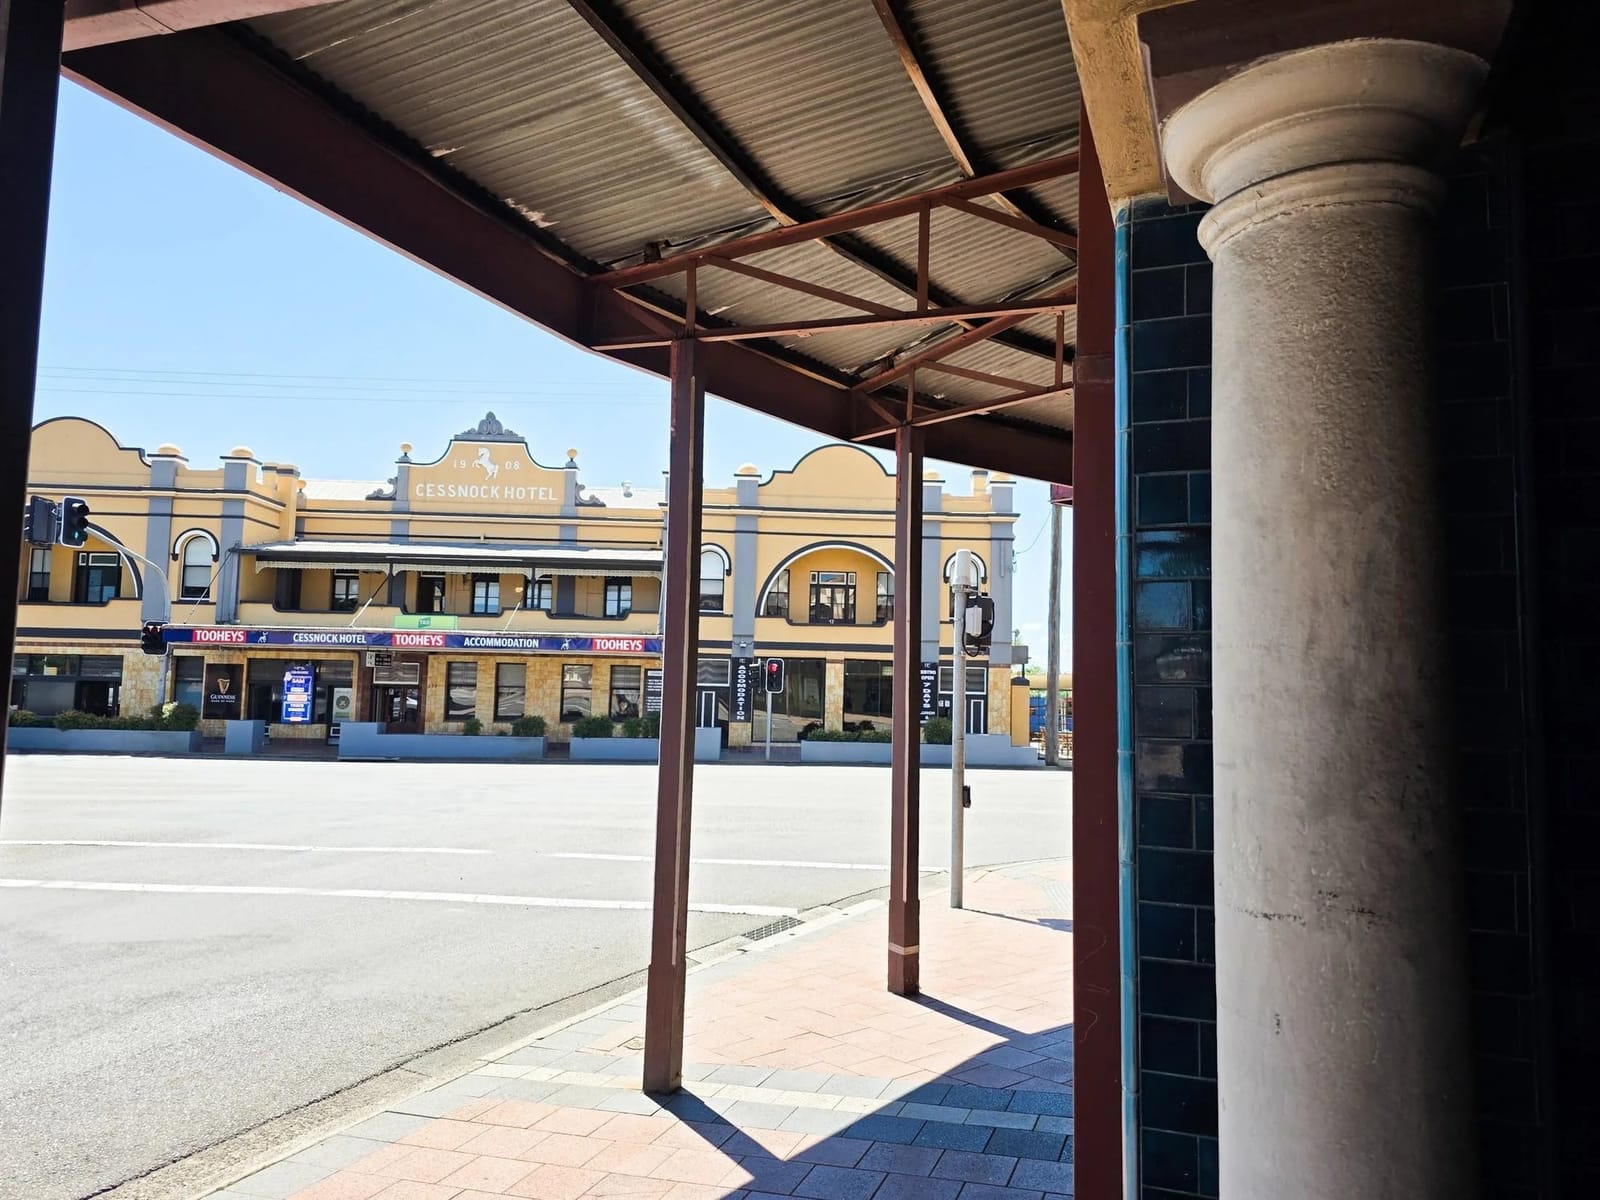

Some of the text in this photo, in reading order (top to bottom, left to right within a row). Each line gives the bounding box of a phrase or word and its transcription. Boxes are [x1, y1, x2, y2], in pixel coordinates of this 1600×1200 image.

[453, 460, 520, 470] 19 08
[415, 484, 558, 500] CESSNOCK HOTEL
[195, 630, 244, 642] TOOHEYS
[293, 633, 367, 644] CESSNOCK HOTEL
[395, 634, 443, 646] TOOHEYS
[463, 637, 539, 648] ACCOMMODATION
[595, 639, 643, 651] TOOHEYS
